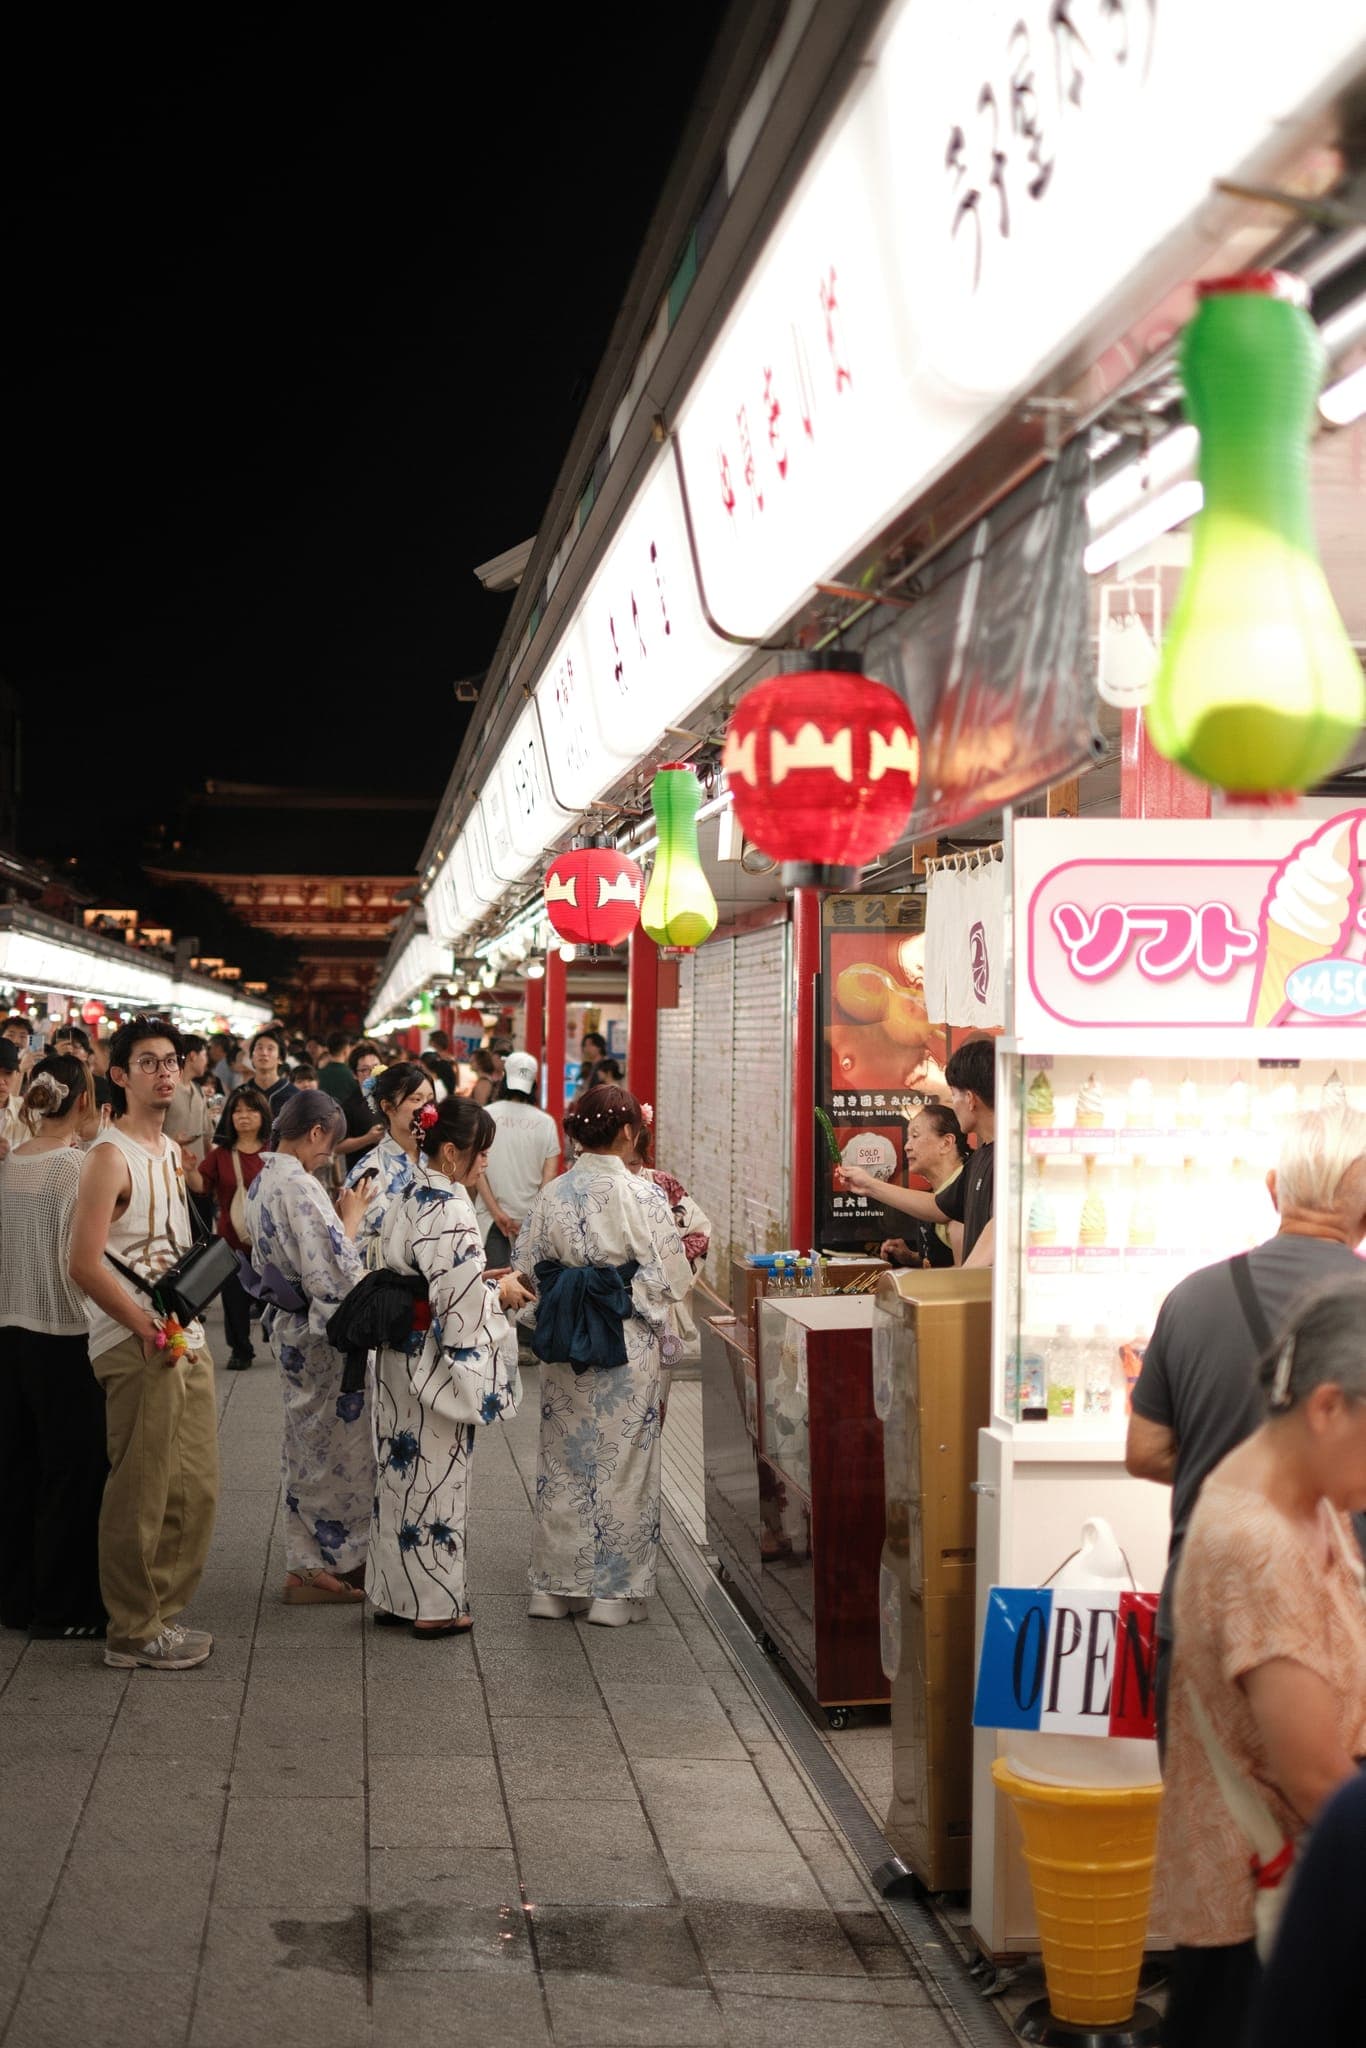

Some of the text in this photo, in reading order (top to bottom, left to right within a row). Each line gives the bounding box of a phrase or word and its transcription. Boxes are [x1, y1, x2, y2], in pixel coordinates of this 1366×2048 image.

[1052, 903, 1260, 981] ソフト
[859, 1149, 879, 1157] SOLD
[1012, 1606, 1158, 1719] OPEN
